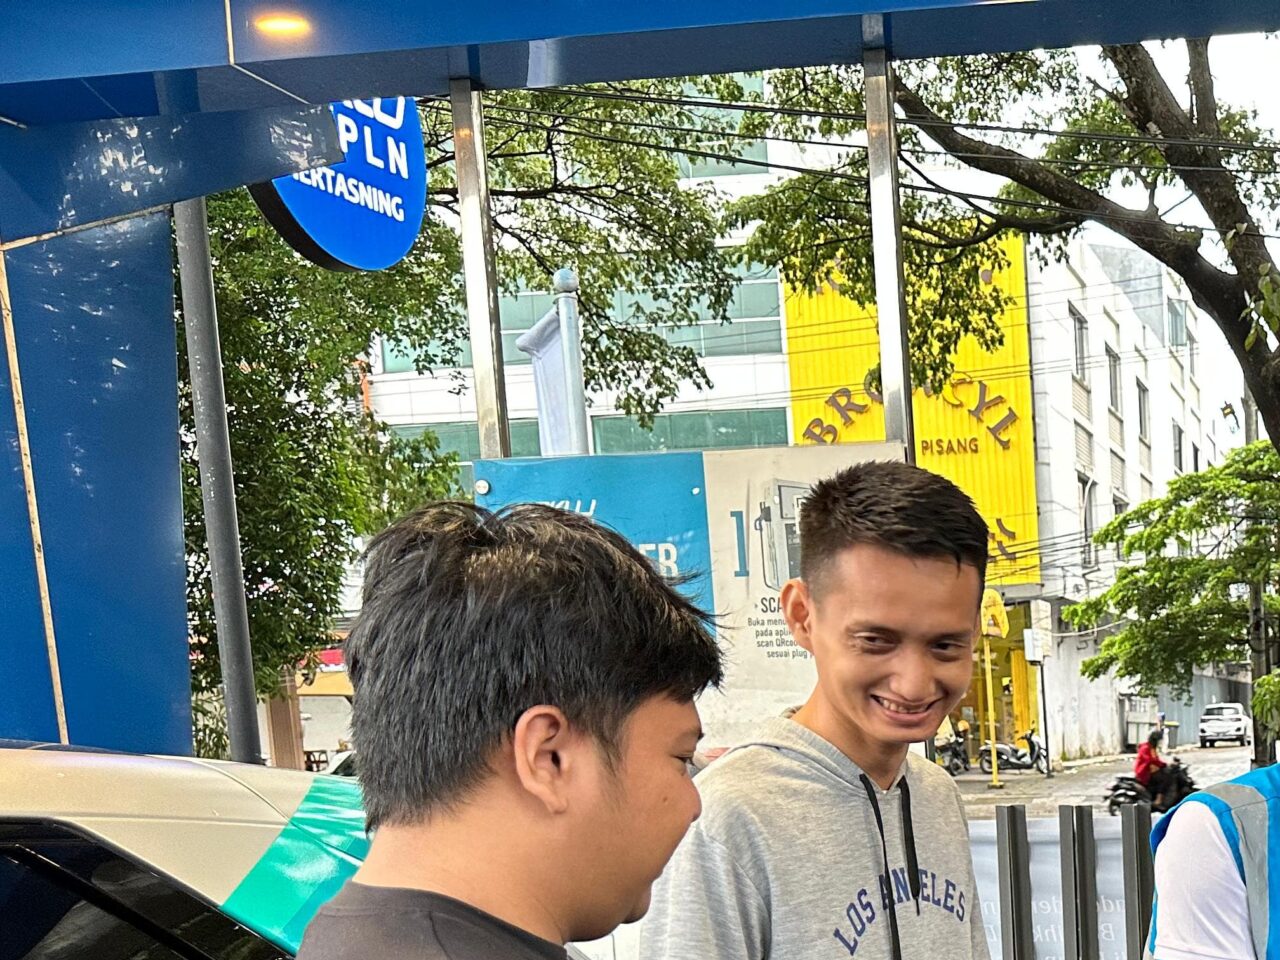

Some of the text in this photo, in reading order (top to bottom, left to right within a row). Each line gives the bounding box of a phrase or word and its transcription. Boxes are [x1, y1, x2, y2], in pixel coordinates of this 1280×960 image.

[338, 112, 409, 180] PLN
[291, 165, 405, 223] ERTASNING
[803, 364, 1018, 450] BRCYL
[921, 437, 979, 455] PISANG
[730, 511, 750, 577] 1
[748, 617, 765, 626] Buka
[755, 628, 773, 639] pada
[757, 640, 774, 648] scan
[767, 650, 790, 658] sesuai
[792, 649, 808, 659] plug
[833, 867, 966, 956] LOS ANELES
